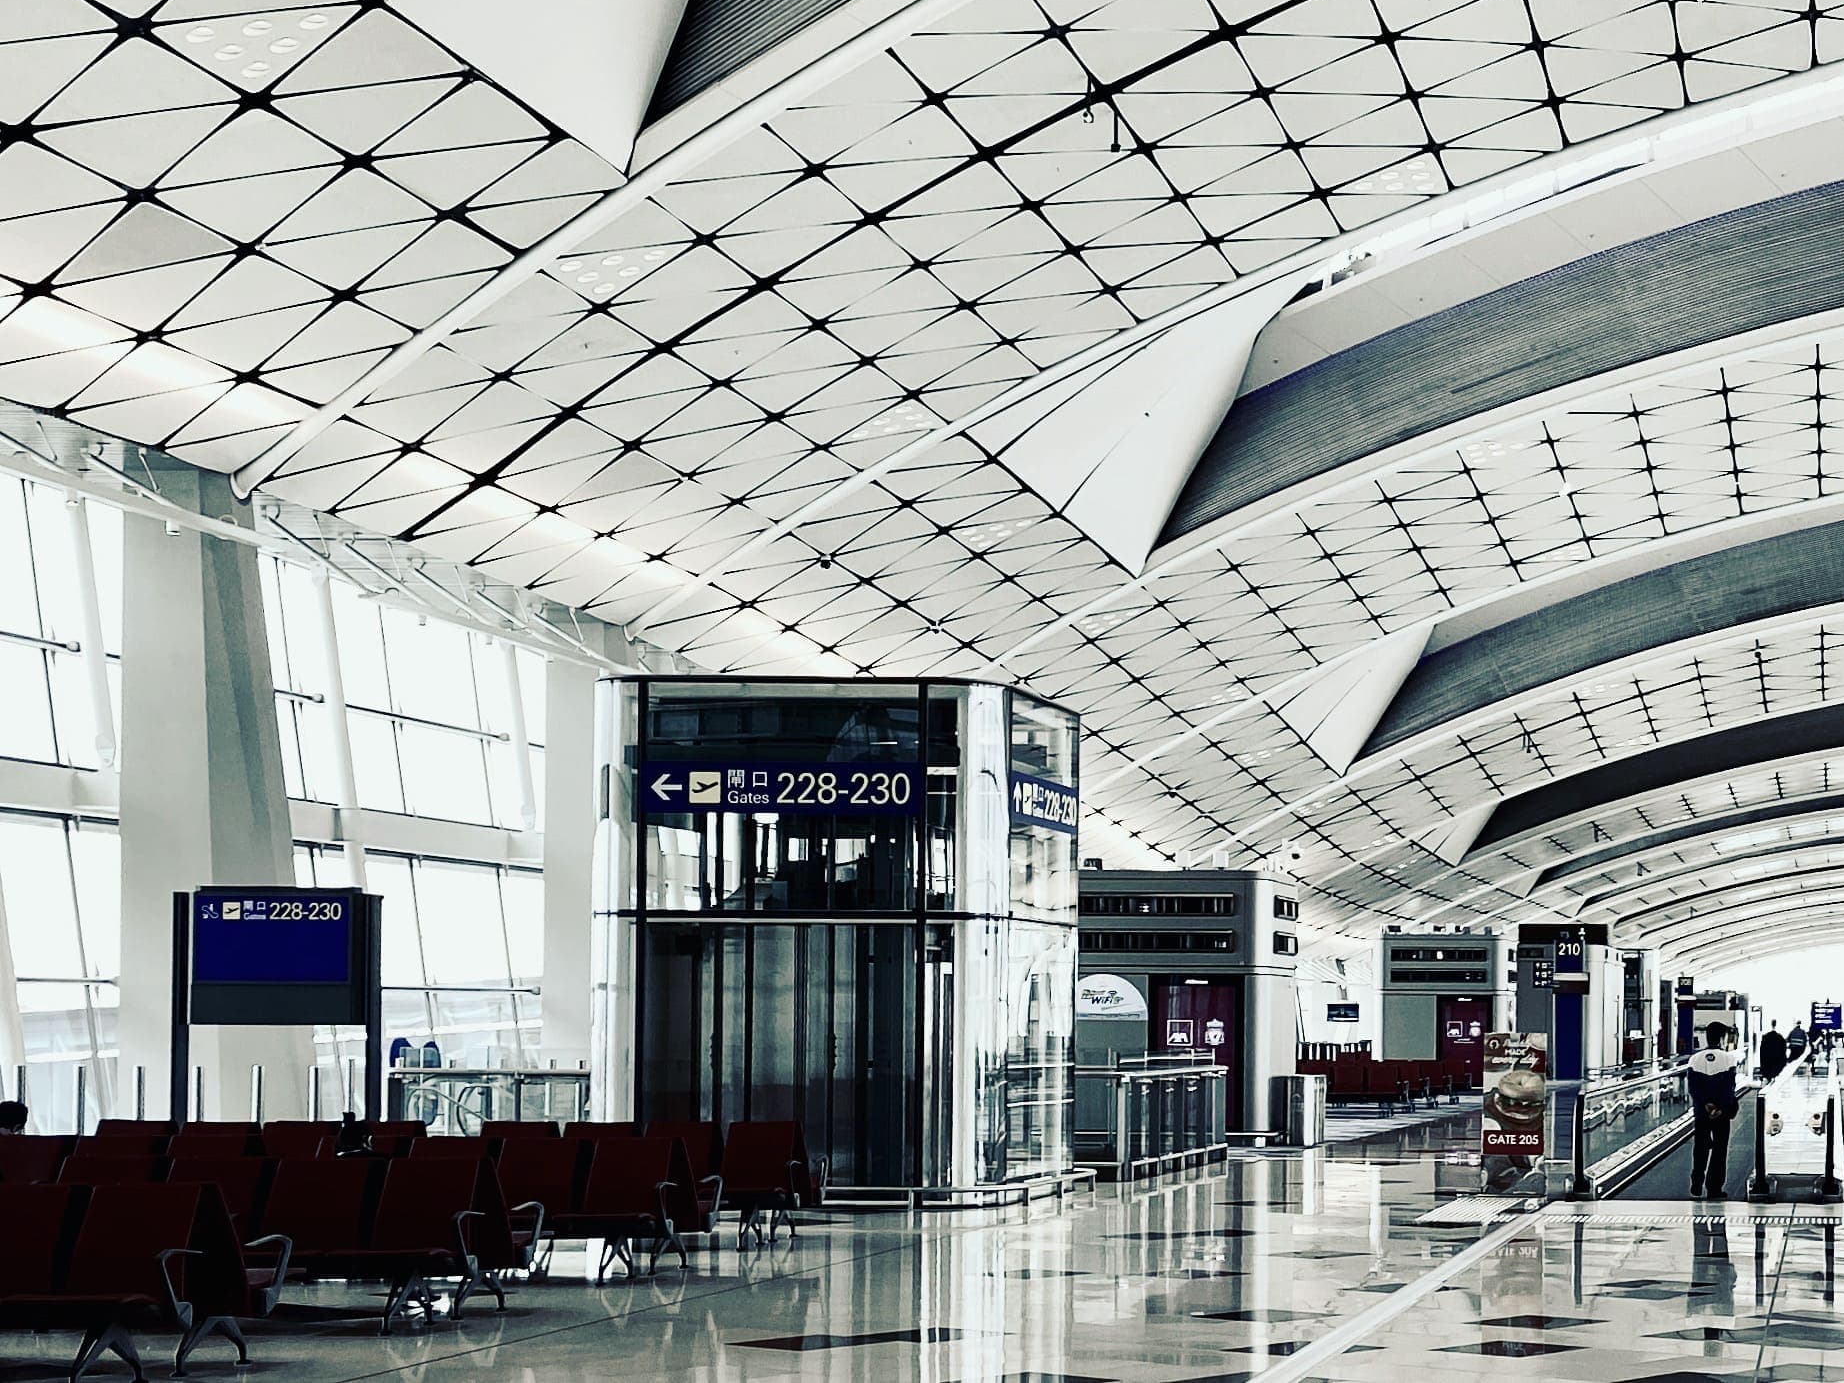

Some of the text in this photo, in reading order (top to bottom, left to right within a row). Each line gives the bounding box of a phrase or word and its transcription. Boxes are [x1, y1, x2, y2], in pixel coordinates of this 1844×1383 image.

[727, 769, 768, 788] 閘口
[777, 772, 911, 804] 228-230
[727, 791, 770, 804] Gates
[1044, 789, 1077, 827] 228-230
[269, 902, 342, 921] 228-230
[1558, 942, 1581, 956] 210
[1487, 1134, 1539, 1145] GATE 205
